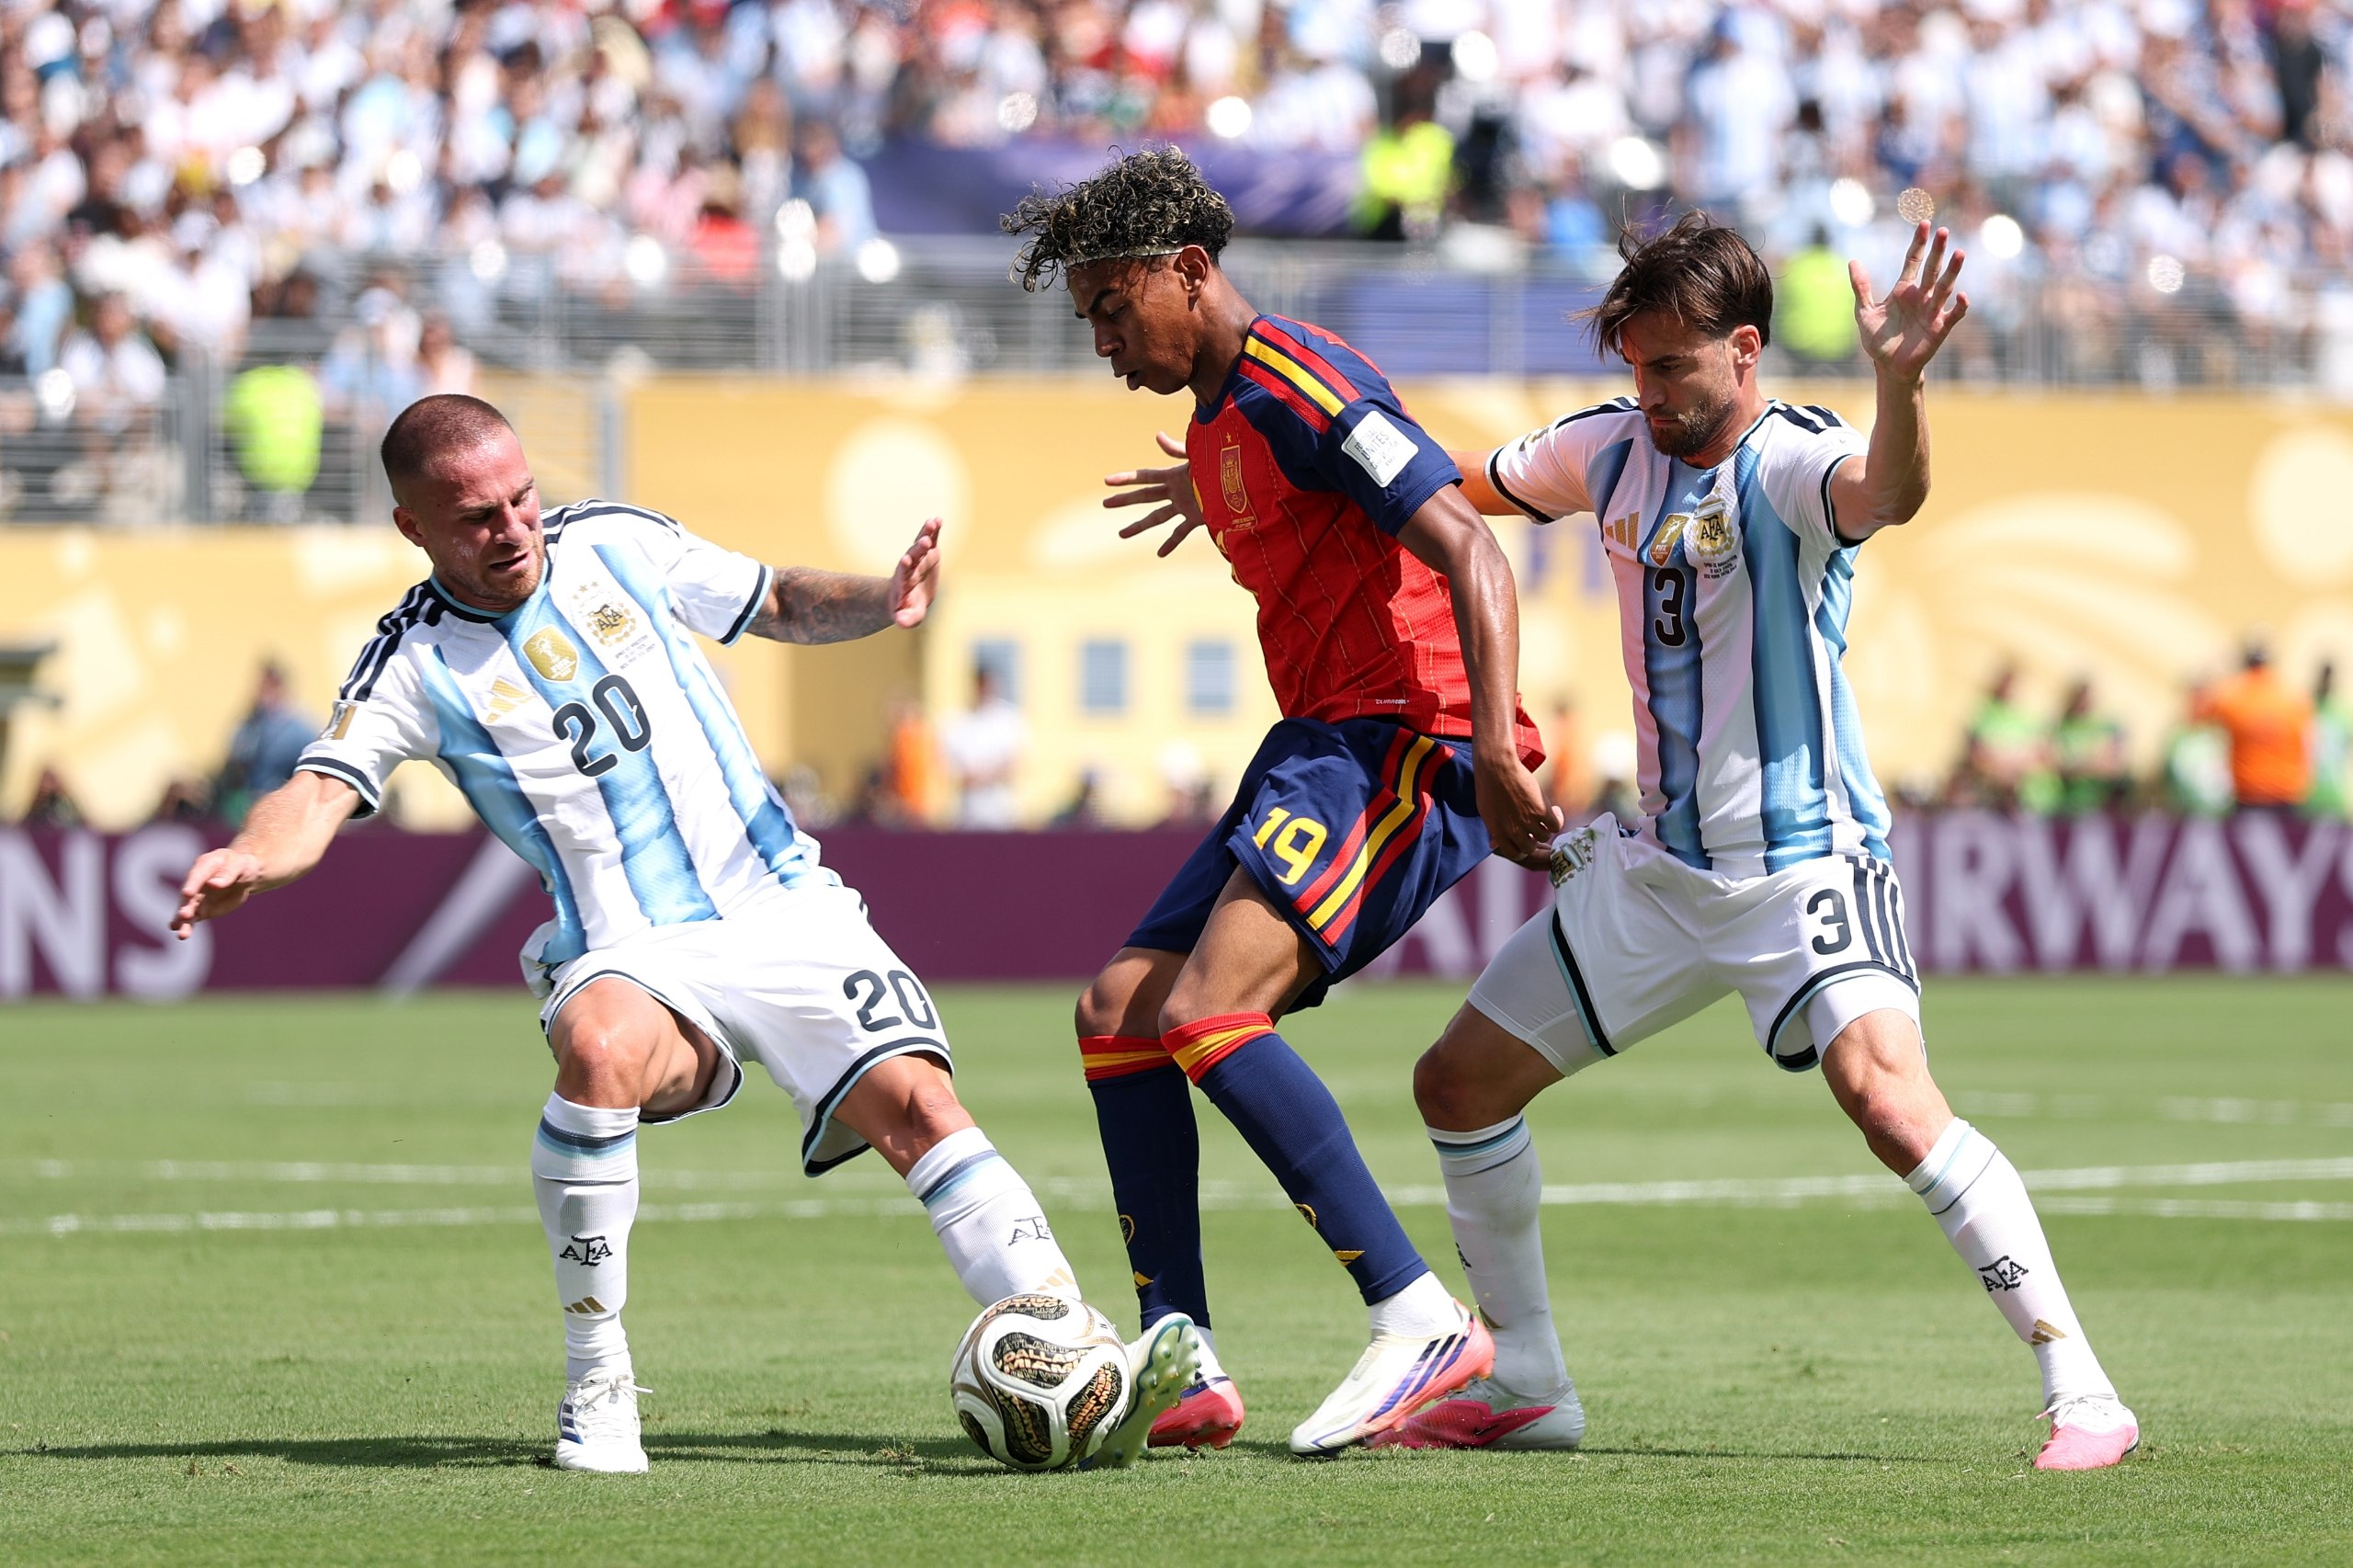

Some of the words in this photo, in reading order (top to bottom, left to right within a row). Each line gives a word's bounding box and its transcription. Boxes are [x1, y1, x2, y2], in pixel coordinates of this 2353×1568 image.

[1360, 429, 1390, 460] UNITES
[1700, 515, 1723, 540] AFA
[594, 604, 623, 631] AFA
[1654, 568, 1687, 646] 3
[552, 675, 652, 778] 20
[1251, 806, 1328, 886] 19
[1891, 811, 2353, 975] IRWAY
[1806, 888, 1852, 955] 3
[843, 969, 937, 1032] 20
[559, 1235, 613, 1266] AFA
[1978, 1256, 2029, 1291] AFA
[1004, 1348, 1078, 1364] DALLAS
[1004, 1358, 1080, 1376] MIAMI
[1097, 1369, 1113, 1403] NEW
[1069, 1395, 1097, 1437] JERSEY
